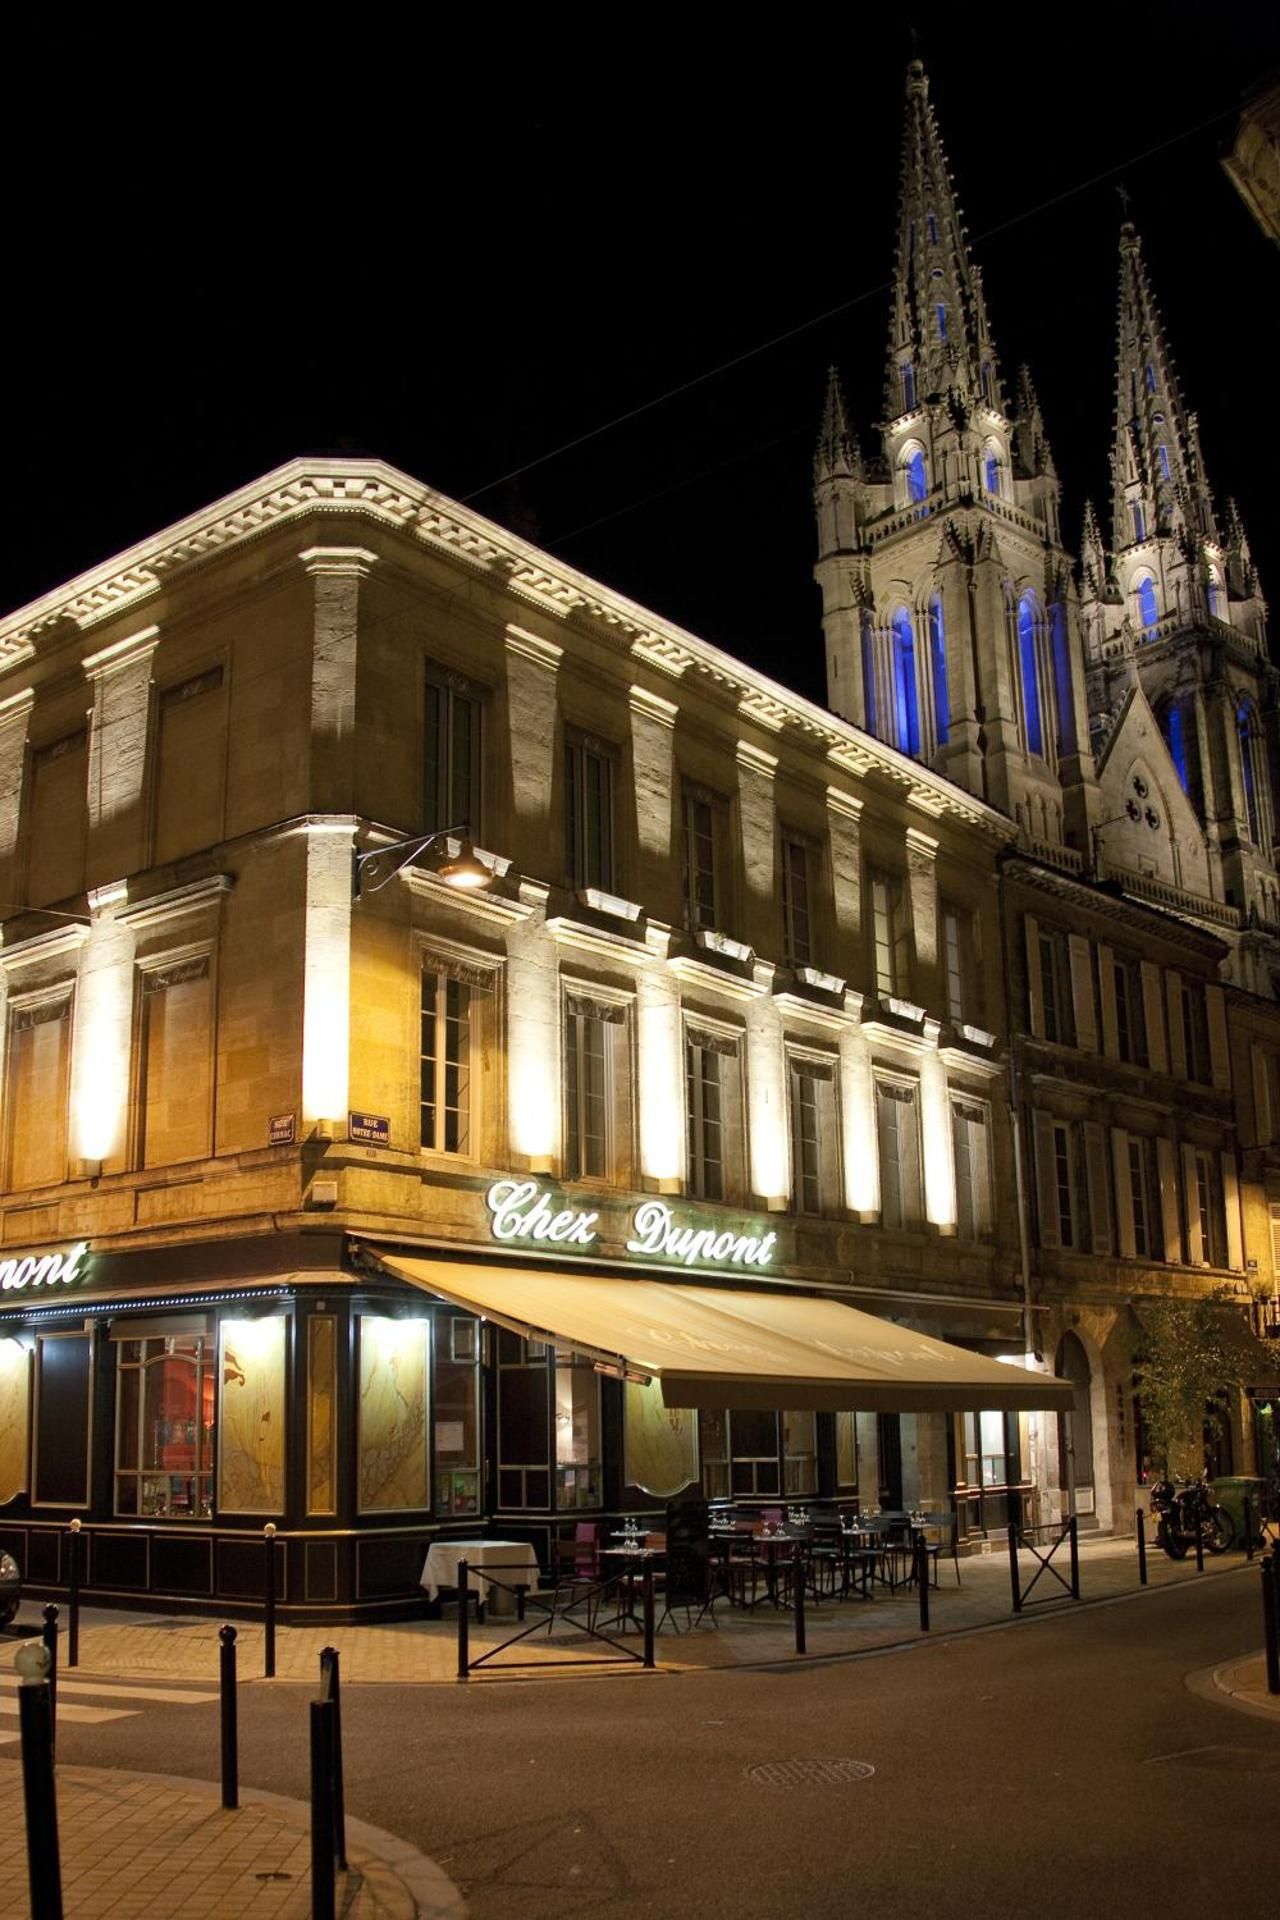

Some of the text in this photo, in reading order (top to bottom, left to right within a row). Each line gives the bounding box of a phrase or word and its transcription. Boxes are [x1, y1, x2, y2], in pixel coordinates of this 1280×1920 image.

[363, 1118, 379, 1129] RUE
[486, 1178, 778, 1265] Chez Dupont
